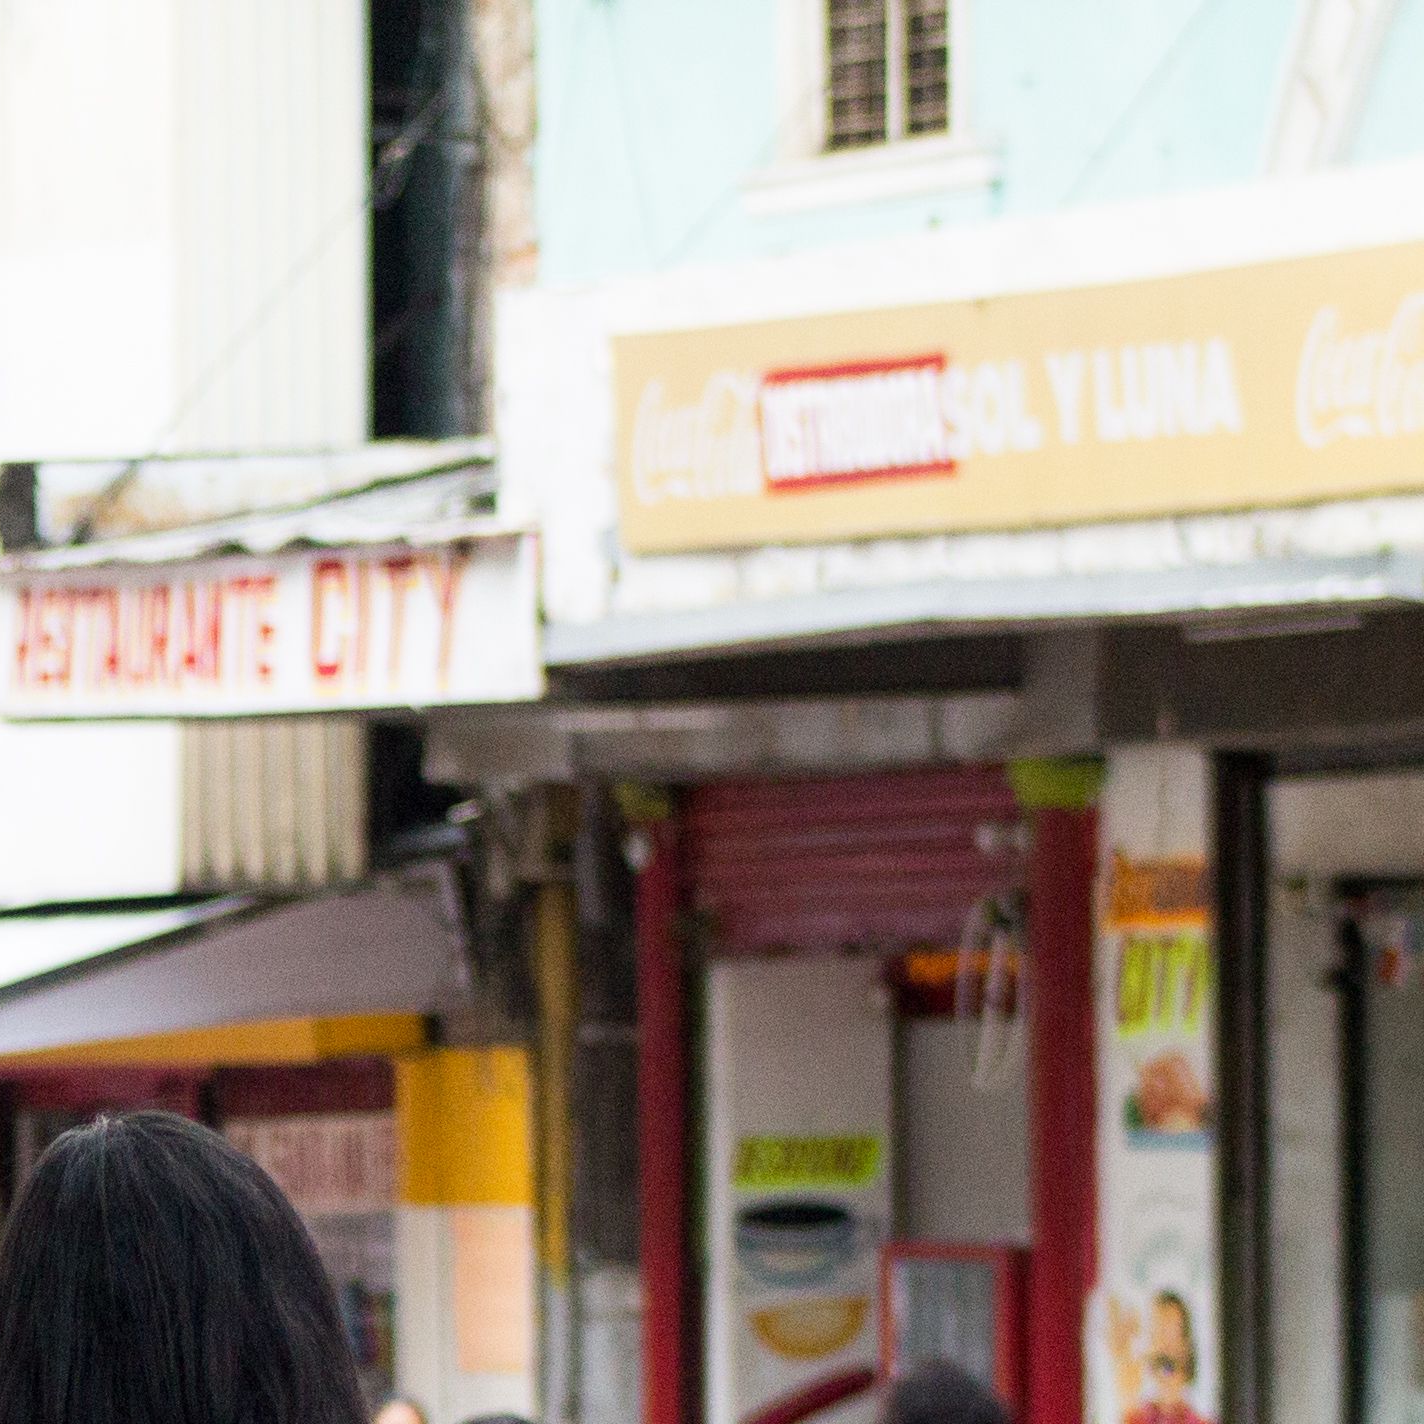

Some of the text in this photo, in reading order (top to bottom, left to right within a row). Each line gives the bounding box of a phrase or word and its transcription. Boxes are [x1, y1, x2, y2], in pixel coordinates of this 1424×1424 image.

[943, 357, 1044, 461] SOL
[1044, 350, 1085, 447] Y
[1092, 335, 1241, 444] LUNA
[310, 552, 474, 692] CITY
